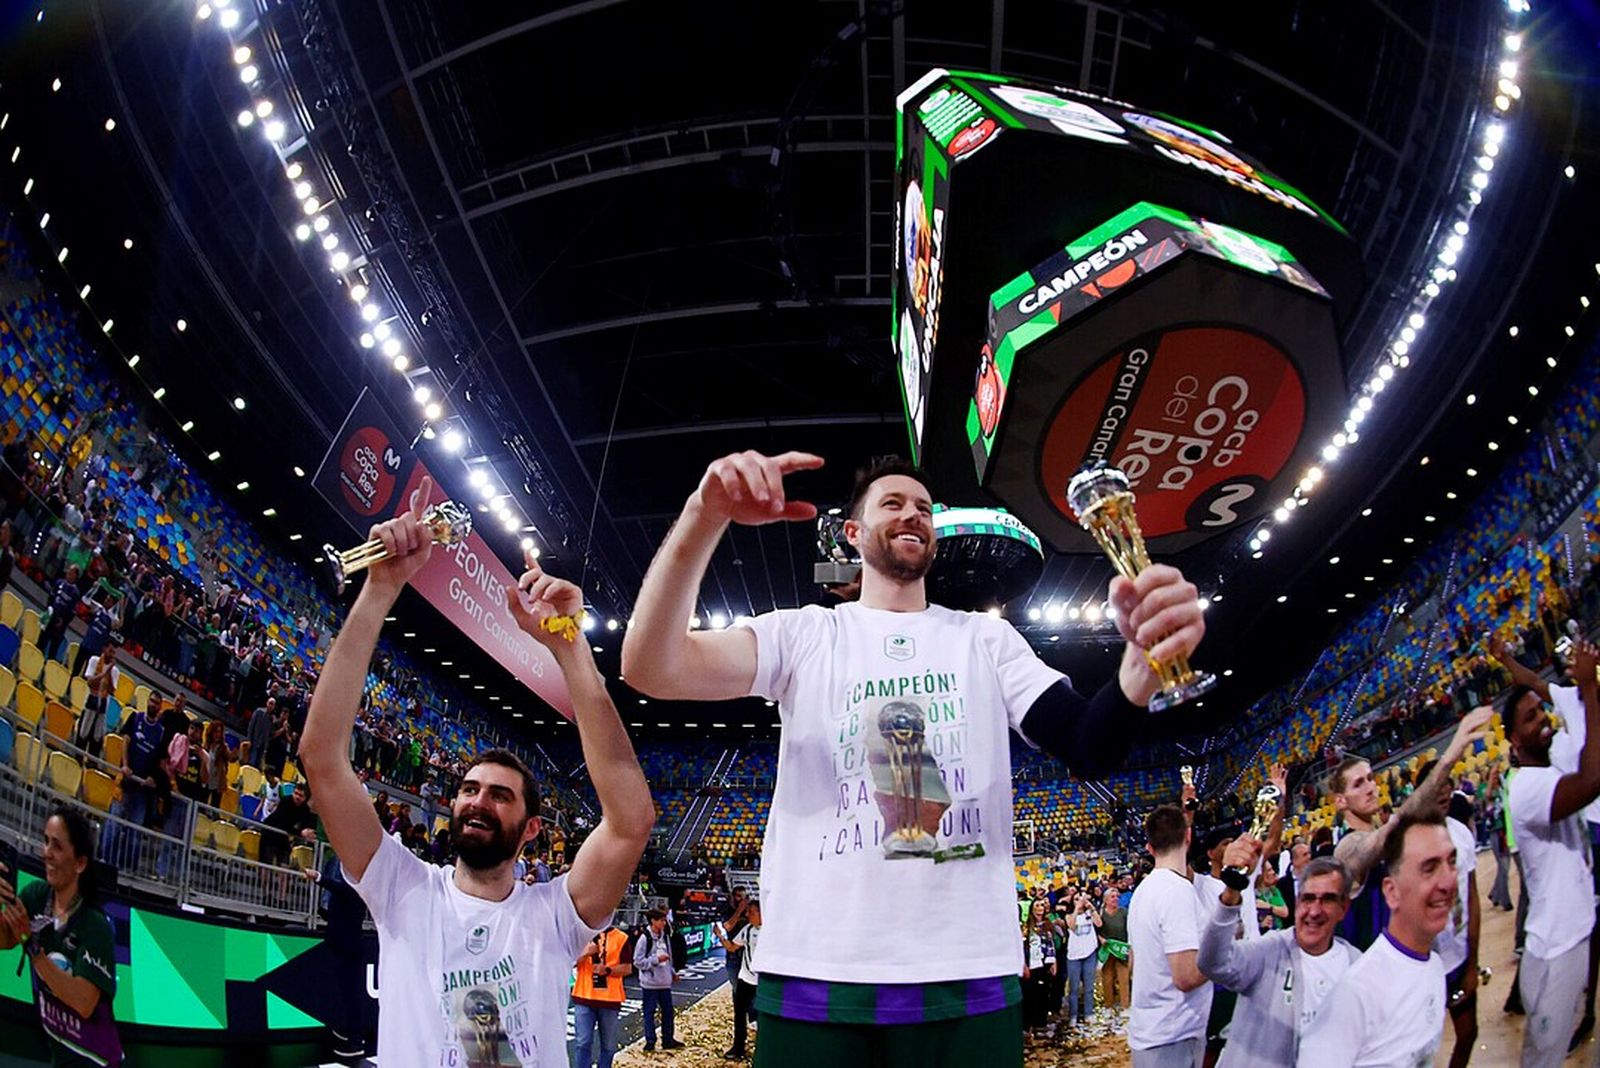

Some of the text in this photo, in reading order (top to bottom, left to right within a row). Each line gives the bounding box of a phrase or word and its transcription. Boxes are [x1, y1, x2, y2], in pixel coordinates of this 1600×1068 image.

[921, 207, 944, 374] UNICAJA
[1018, 229, 1150, 315] CAMPEÓN
[1090, 348, 1148, 460] Gran Canar
[1117, 375, 1200, 488] del Re
[1157, 375, 1249, 490] Copa
[1212, 409, 1259, 467] acb
[354, 448, 379, 482] Copa
[358, 473, 377, 498] Rey
[450, 577, 483, 622] Gran
[846, 668, 957, 712] ¡CAMPEÓN!
